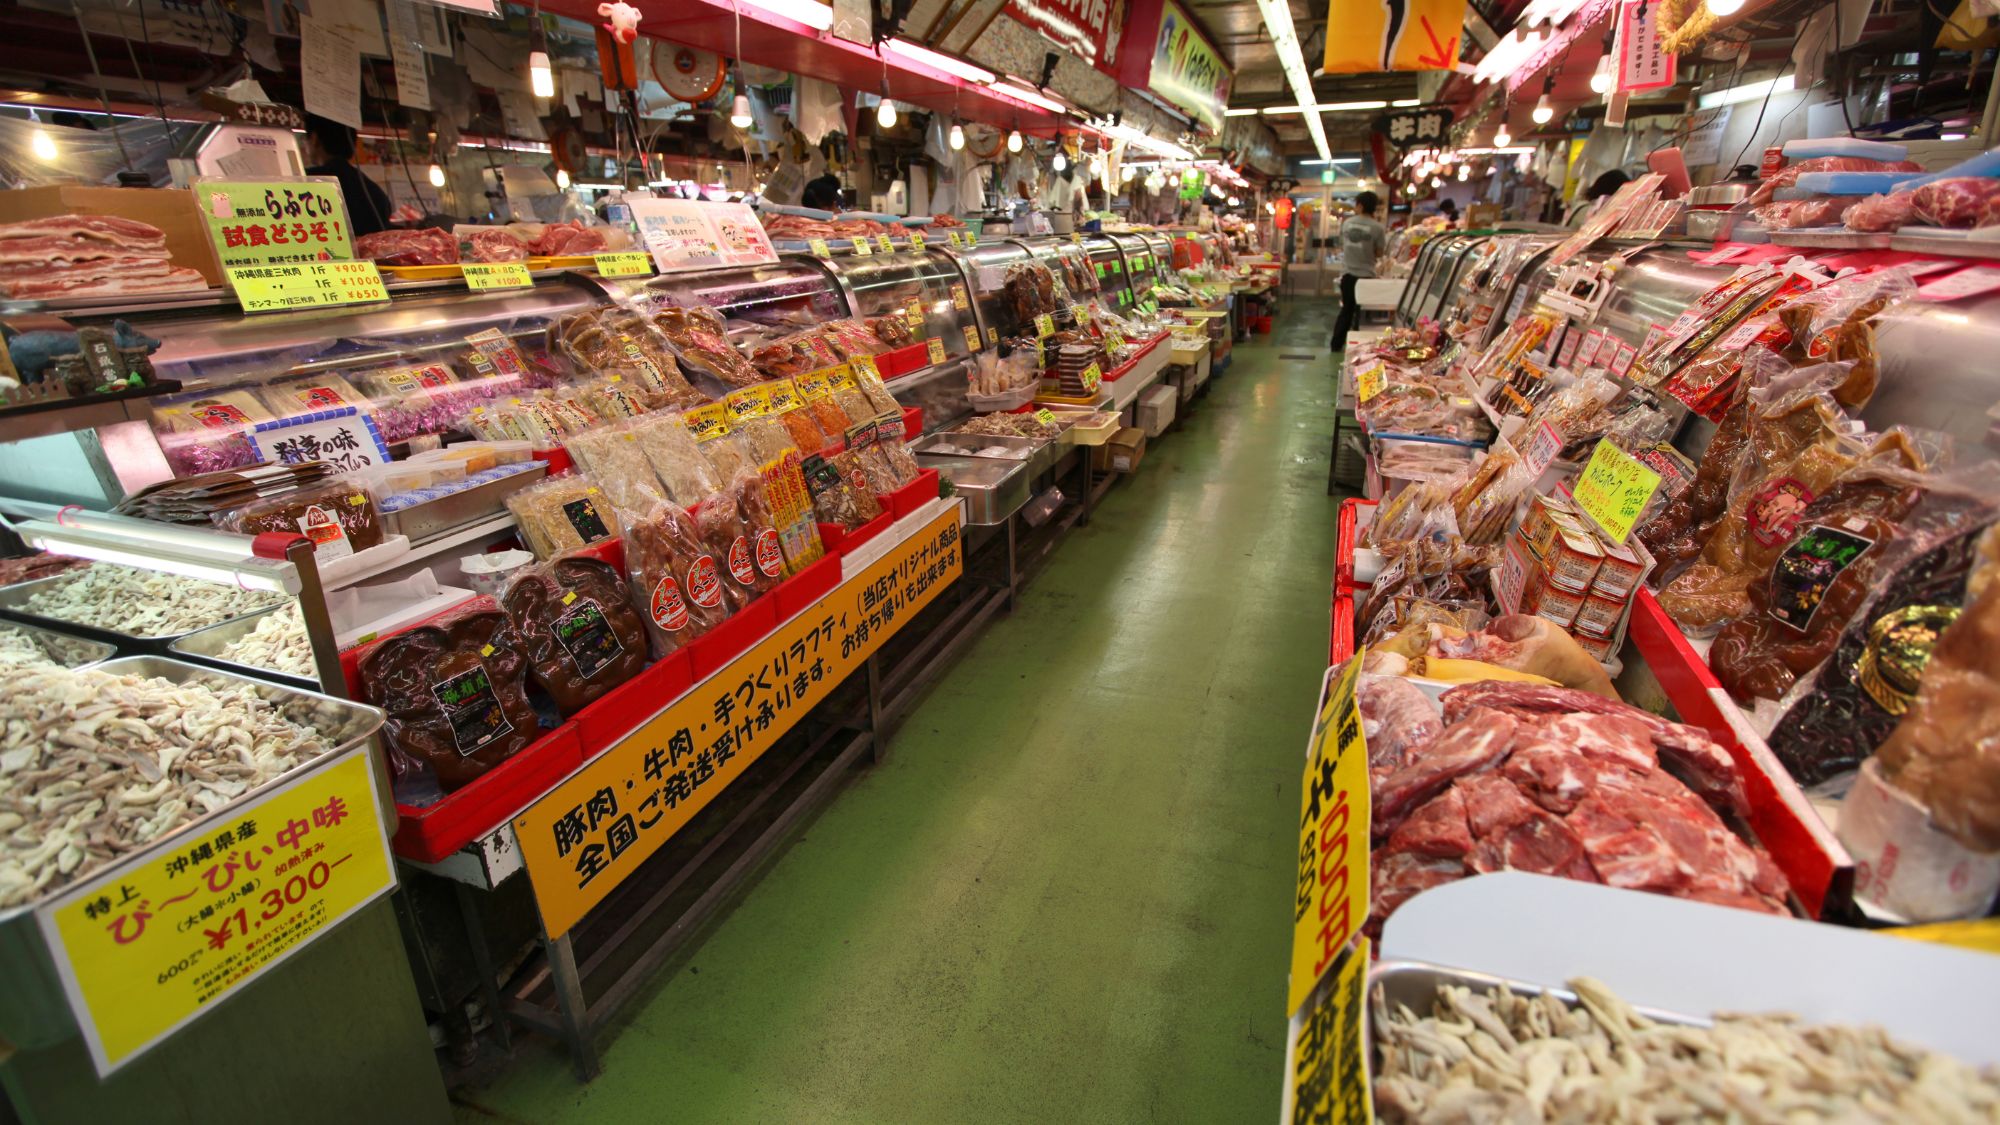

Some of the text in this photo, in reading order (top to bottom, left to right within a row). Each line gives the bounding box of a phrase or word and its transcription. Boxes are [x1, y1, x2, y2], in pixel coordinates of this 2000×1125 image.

[1390, 114, 1442, 141] 牛肉
[236, 208, 265, 218] 無添加
[222, 221, 343, 248] 試食どうぞ！
[234, 267, 302, 280] 沖縄県産三枚肉
[273, 427, 360, 464] 料亭の味
[84, 818, 259, 921] 特上 沖縄県産
[1314, 789, 1350, 978] 1000円
